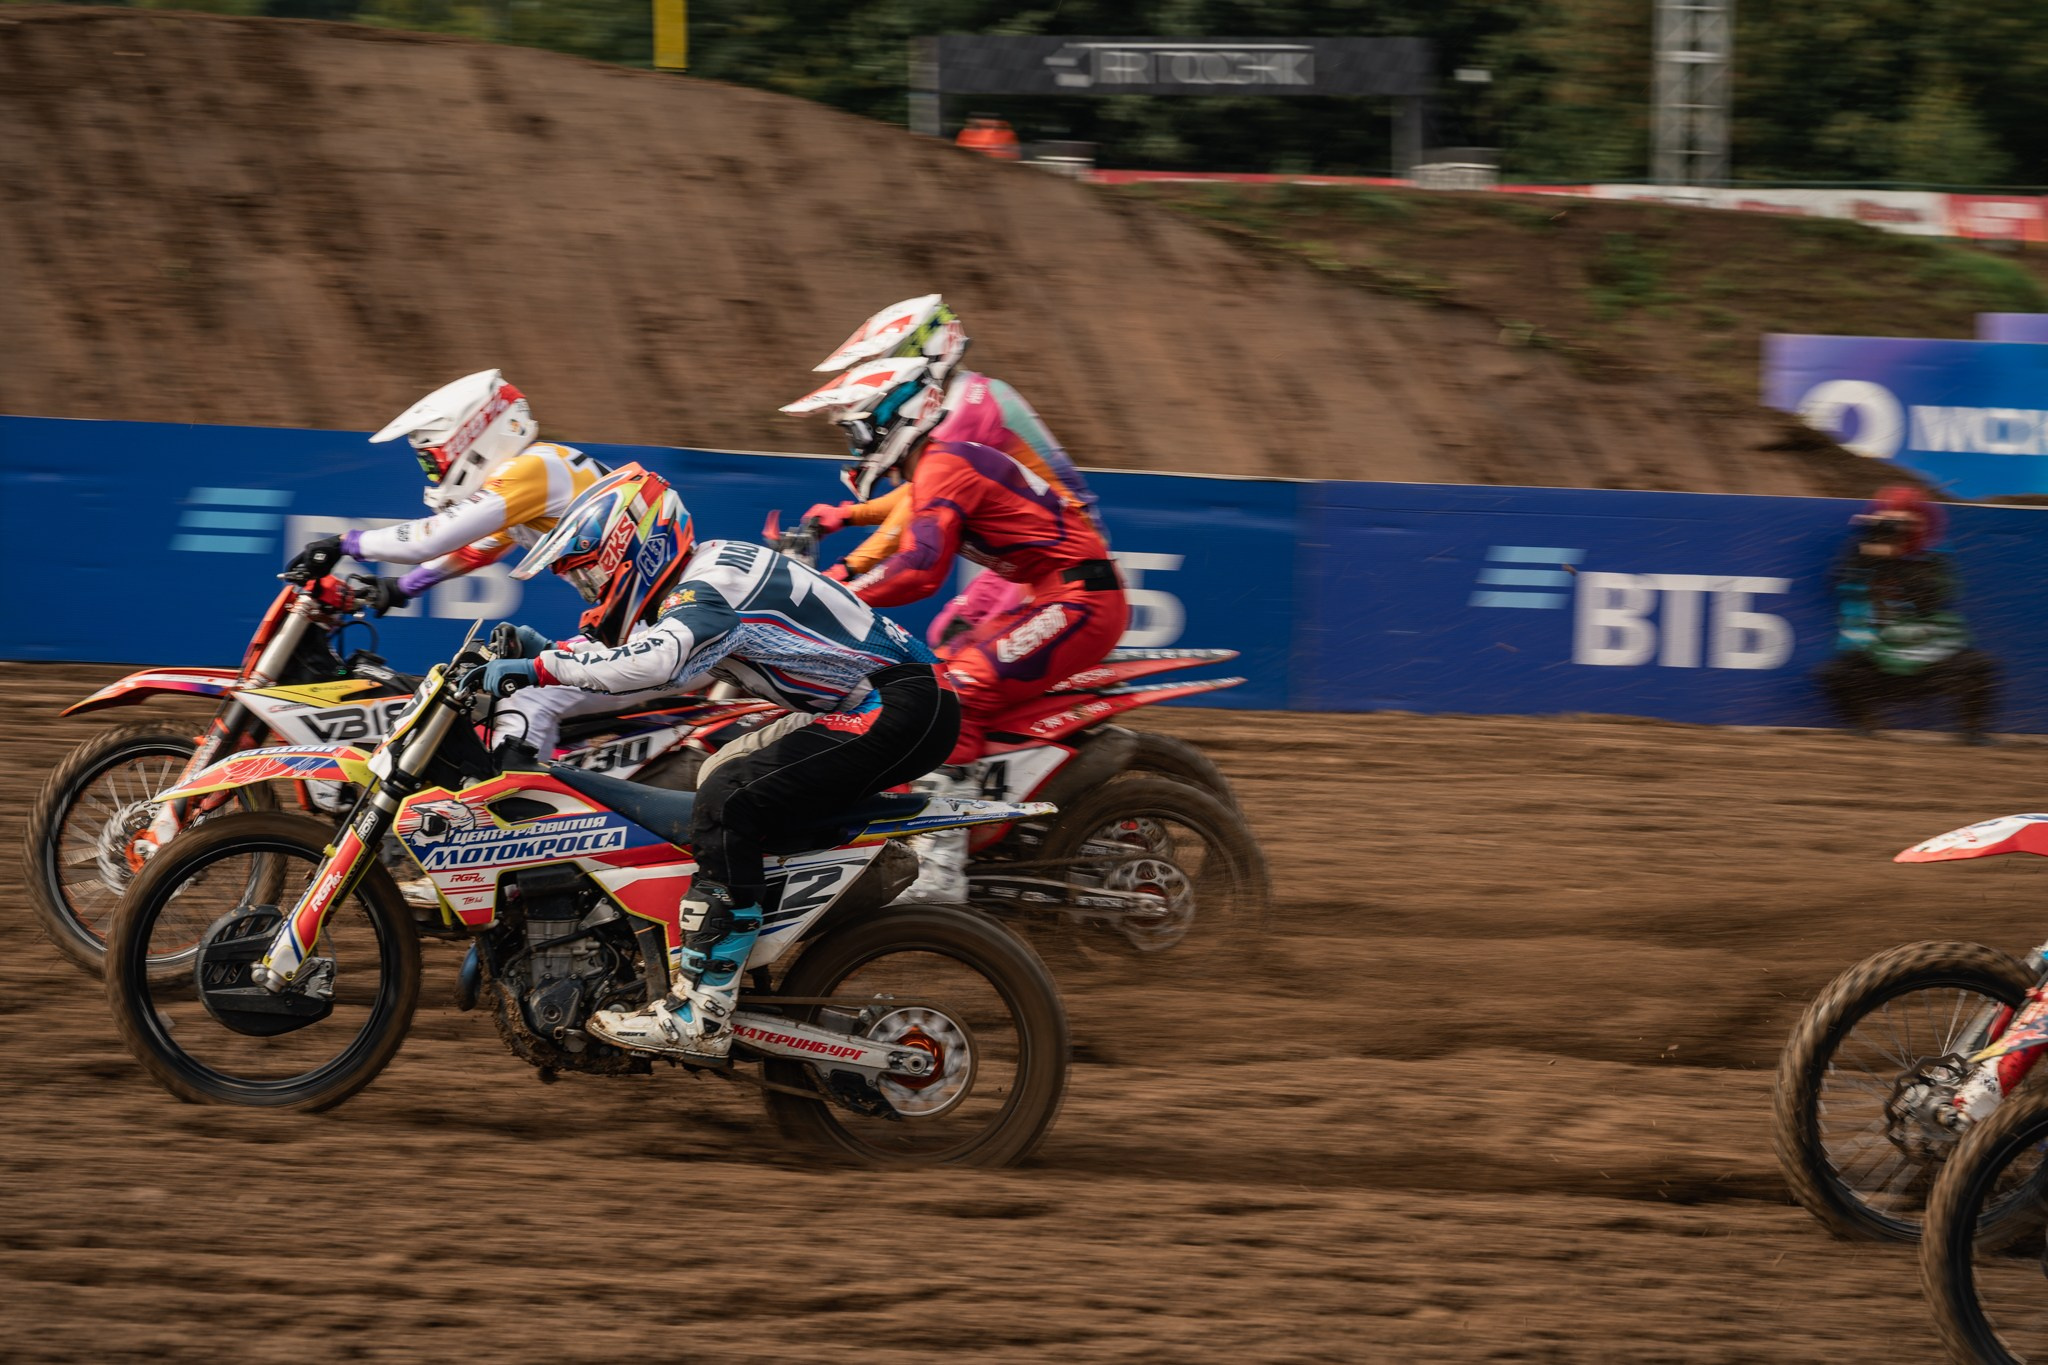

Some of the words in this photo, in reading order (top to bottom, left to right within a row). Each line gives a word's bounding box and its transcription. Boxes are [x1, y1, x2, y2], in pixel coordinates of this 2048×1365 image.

[1572, 571, 1794, 670] ВТБ
[428, 828, 626, 870] МОТОКРОССА
[452, 827, 513, 844] ЦЕНТР
[512, 815, 607, 838] РАЗВИТИЯ
[731, 1023, 868, 1060] КАТЕРИНБУРГ
